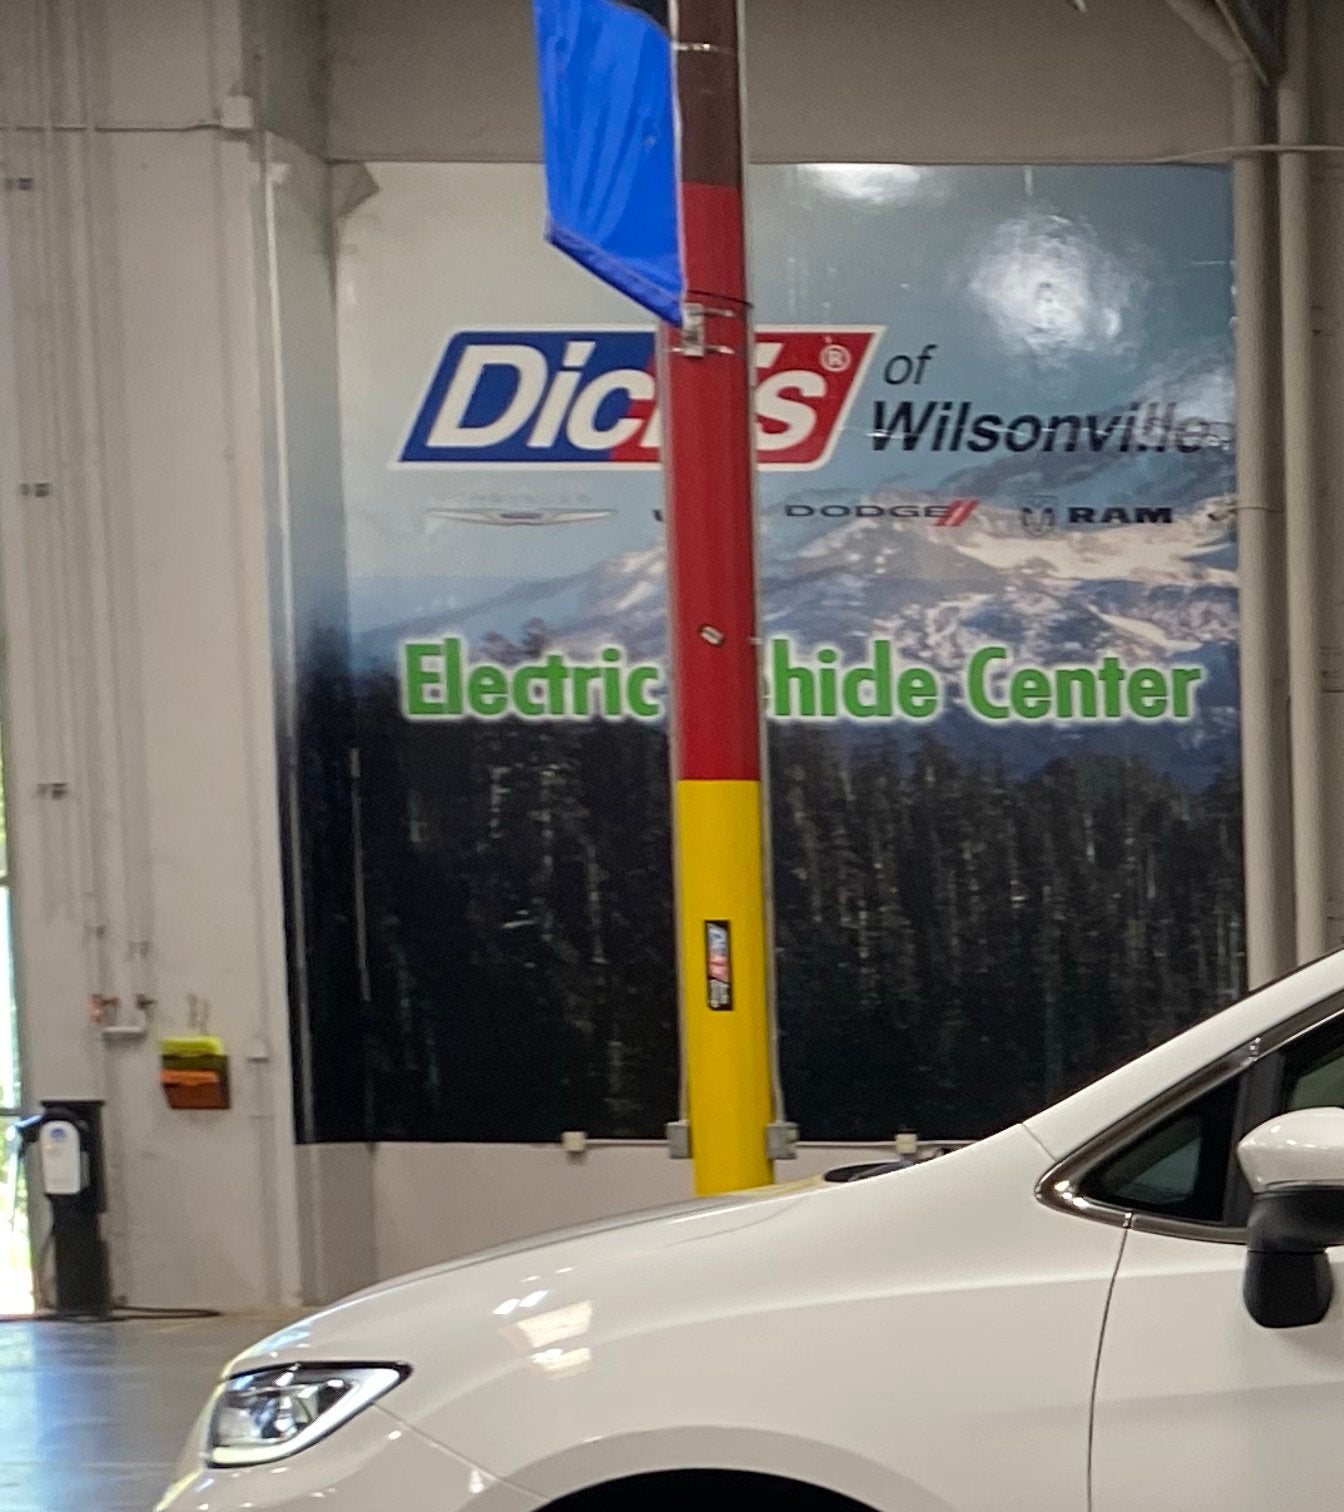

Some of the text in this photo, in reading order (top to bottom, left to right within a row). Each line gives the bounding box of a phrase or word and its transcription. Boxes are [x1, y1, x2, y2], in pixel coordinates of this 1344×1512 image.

[426, 341, 937, 450] Dic's of
[871, 401, 1209, 453] Wilsonville
[784, 504, 950, 518] DODGE
[1068, 506, 1173, 524] RAM
[404, 637, 1202, 719] Electric hicle Center
